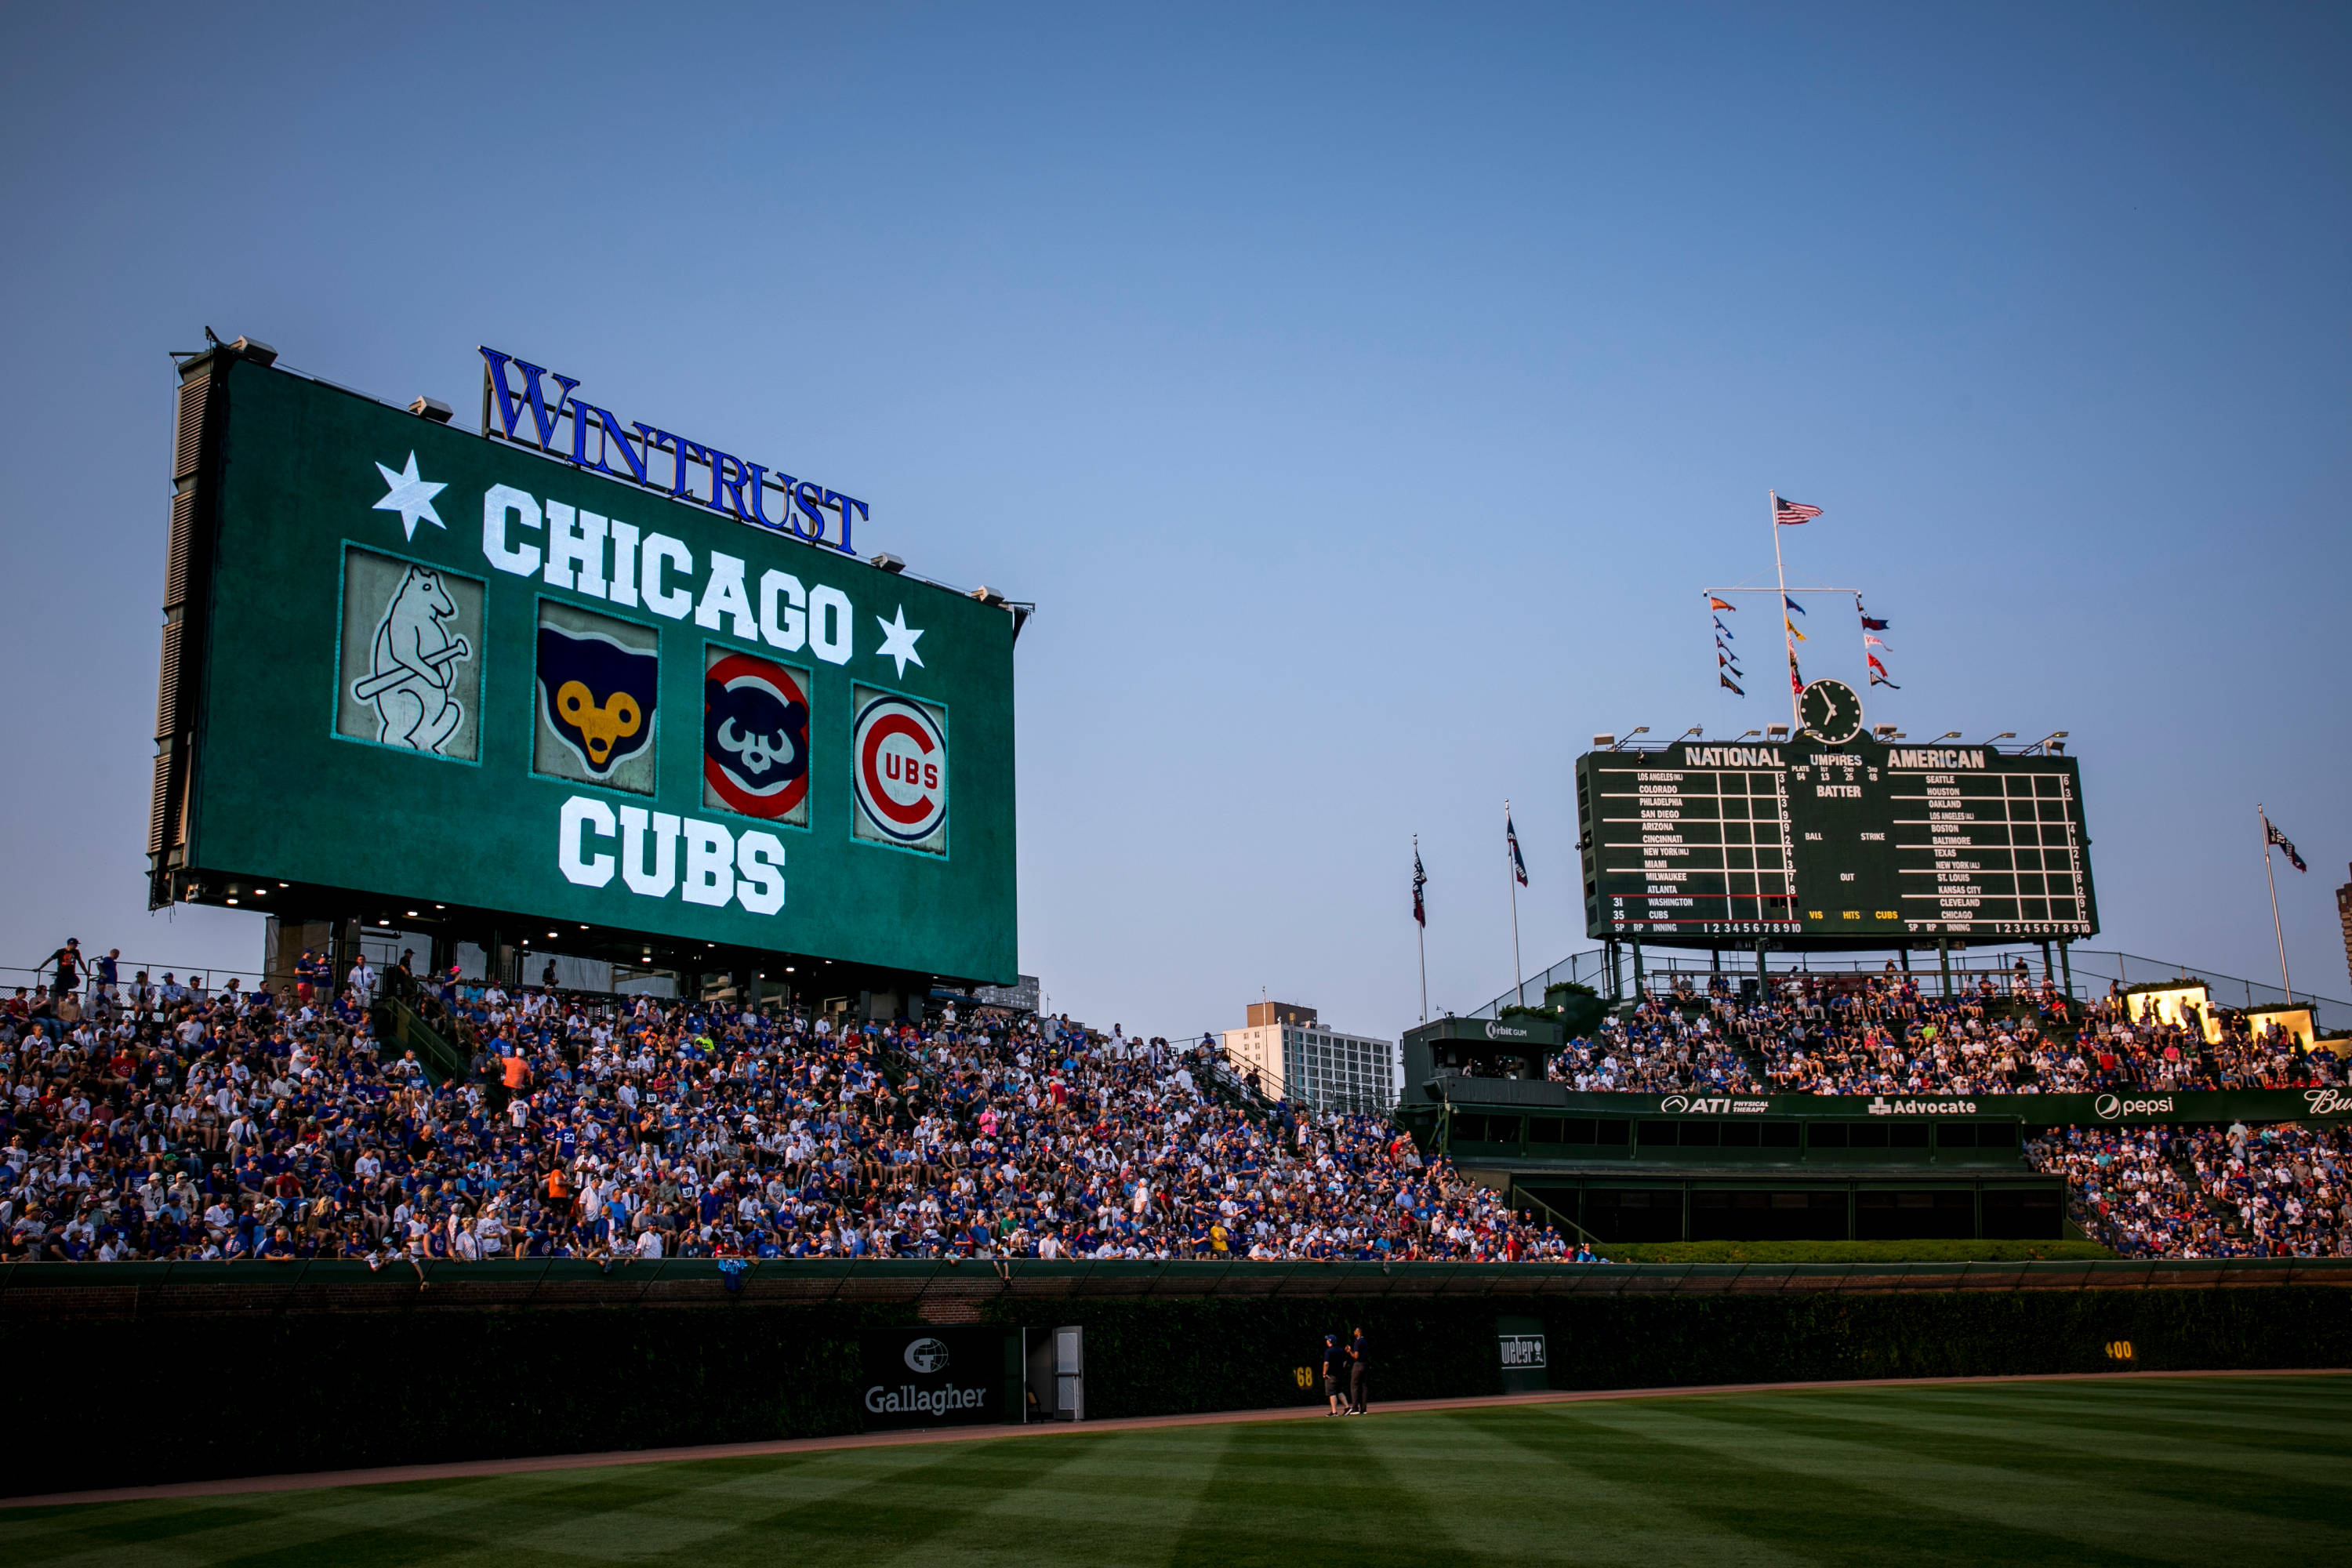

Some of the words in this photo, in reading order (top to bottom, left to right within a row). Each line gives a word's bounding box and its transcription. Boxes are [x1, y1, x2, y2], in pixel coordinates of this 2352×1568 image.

[478, 346, 869, 555] WINTRUST
[483, 483, 853, 666] CHICAGO
[1686, 747, 1785, 767] NATIONAL
[1810, 754, 1863, 766] UMPIRES
[1888, 750, 1985, 768] AMERICAN
[1779, 774, 1785, 782] 3
[1796, 772, 1806, 781] 64
[1821, 772, 1830, 781] 13
[1926, 775, 1955, 784] SEATTLE
[2063, 777, 2069, 786] 6
[1639, 786, 1678, 794] COLORADO
[1780, 786, 1786, 795] 4
[1817, 785, 1862, 797] BATTER
[2065, 789, 2071, 797] 3
[1639, 798, 1682, 807] PHILADELPHIA
[1781, 799, 1788, 808] 3
[1929, 800, 1961, 808] OAKLAND
[1641, 810, 1655, 818] SAN
[1657, 810, 1679, 818] DIEGO
[1782, 811, 1788, 819] 9
[1642, 822, 1673, 831] ARIZONA
[1784, 823, 1790, 832] 9
[1931, 824, 1958, 833] BOSTON
[2070, 825, 2075, 833] 4
[1643, 835, 1682, 844] CINCINNATI
[1784, 836, 1791, 844] 2
[1933, 837, 1971, 845] BALTIMORE
[559, 795, 786, 915] CUBS
[1786, 848, 1791, 857] 4
[2073, 850, 2079, 858] 2
[1645, 860, 1667, 869] MIAMI
[1787, 860, 1793, 869] 3
[1936, 861, 1951, 869] NEW
[1646, 873, 1687, 881] MILWAUKEE
[1788, 873, 1794, 882] 7
[1937, 873, 1948, 882] ST.
[1950, 873, 1969, 882] LOUIS
[2076, 874, 2082, 883] 8
[1647, 885, 1678, 894] ATLANTA
[1789, 885, 1795, 895] 8
[1938, 886, 1965, 895] KANSAS
[1966, 886, 1981, 895] CITY
[1648, 898, 1693, 907] WASHINGTON
[1940, 898, 1980, 907] CLEVELAND
[2079, 899, 2085, 908] 9
[1613, 910, 1624, 920] 35
[1650, 910, 1668, 920] CUBS
[1875, 911, 1898, 920] CUBS
[1941, 911, 1973, 920] CHICAGO
[1615, 924, 1624, 932] SP
[1634, 924, 1643, 932] RP
[1653, 924, 1677, 932] INNING
[1704, 924, 1708, 932] 1
[1713, 924, 1719, 932] 2
[1725, 924, 1730, 932] 3
[1733, 924, 1740, 932] 4
[1744, 924, 1750, 932] 5
[1753, 924, 1759, 932] 6
[1763, 924, 1769, 932] 7
[1773, 924, 1780, 932] 8
[1783, 924, 1789, 932] 9
[1791, 924, 1801, 932] 10
[1947, 924, 1970, 932] INNING
[1996, 924, 1999, 932] 1
[2005, 924, 2011, 932] 2
[2015, 924, 2020, 932] 3
[2024, 924, 2030, 932] 4
[2034, 924, 2040, 932] 5
[2043, 924, 2049, 933] 6
[2053, 924, 2059, 933] 7
[2063, 924, 2069, 933] 8
[2072, 924, 2078, 933] 9
[2081, 924, 2090, 933] 10
[1689, 1098, 1731, 1113] ATI
[2124, 1096, 2173, 1116] pepsi
[2304, 1089, 2352, 1114] Bu
[1893, 1100, 1976, 1114] Advocate
[564, 1132, 575, 1143] 23
[1501, 1338, 1534, 1364] weber
[2105, 1341, 2132, 1359] 400
[1293, 1367, 1312, 1386] 68
[866, 1383, 986, 1416] Gallagher
